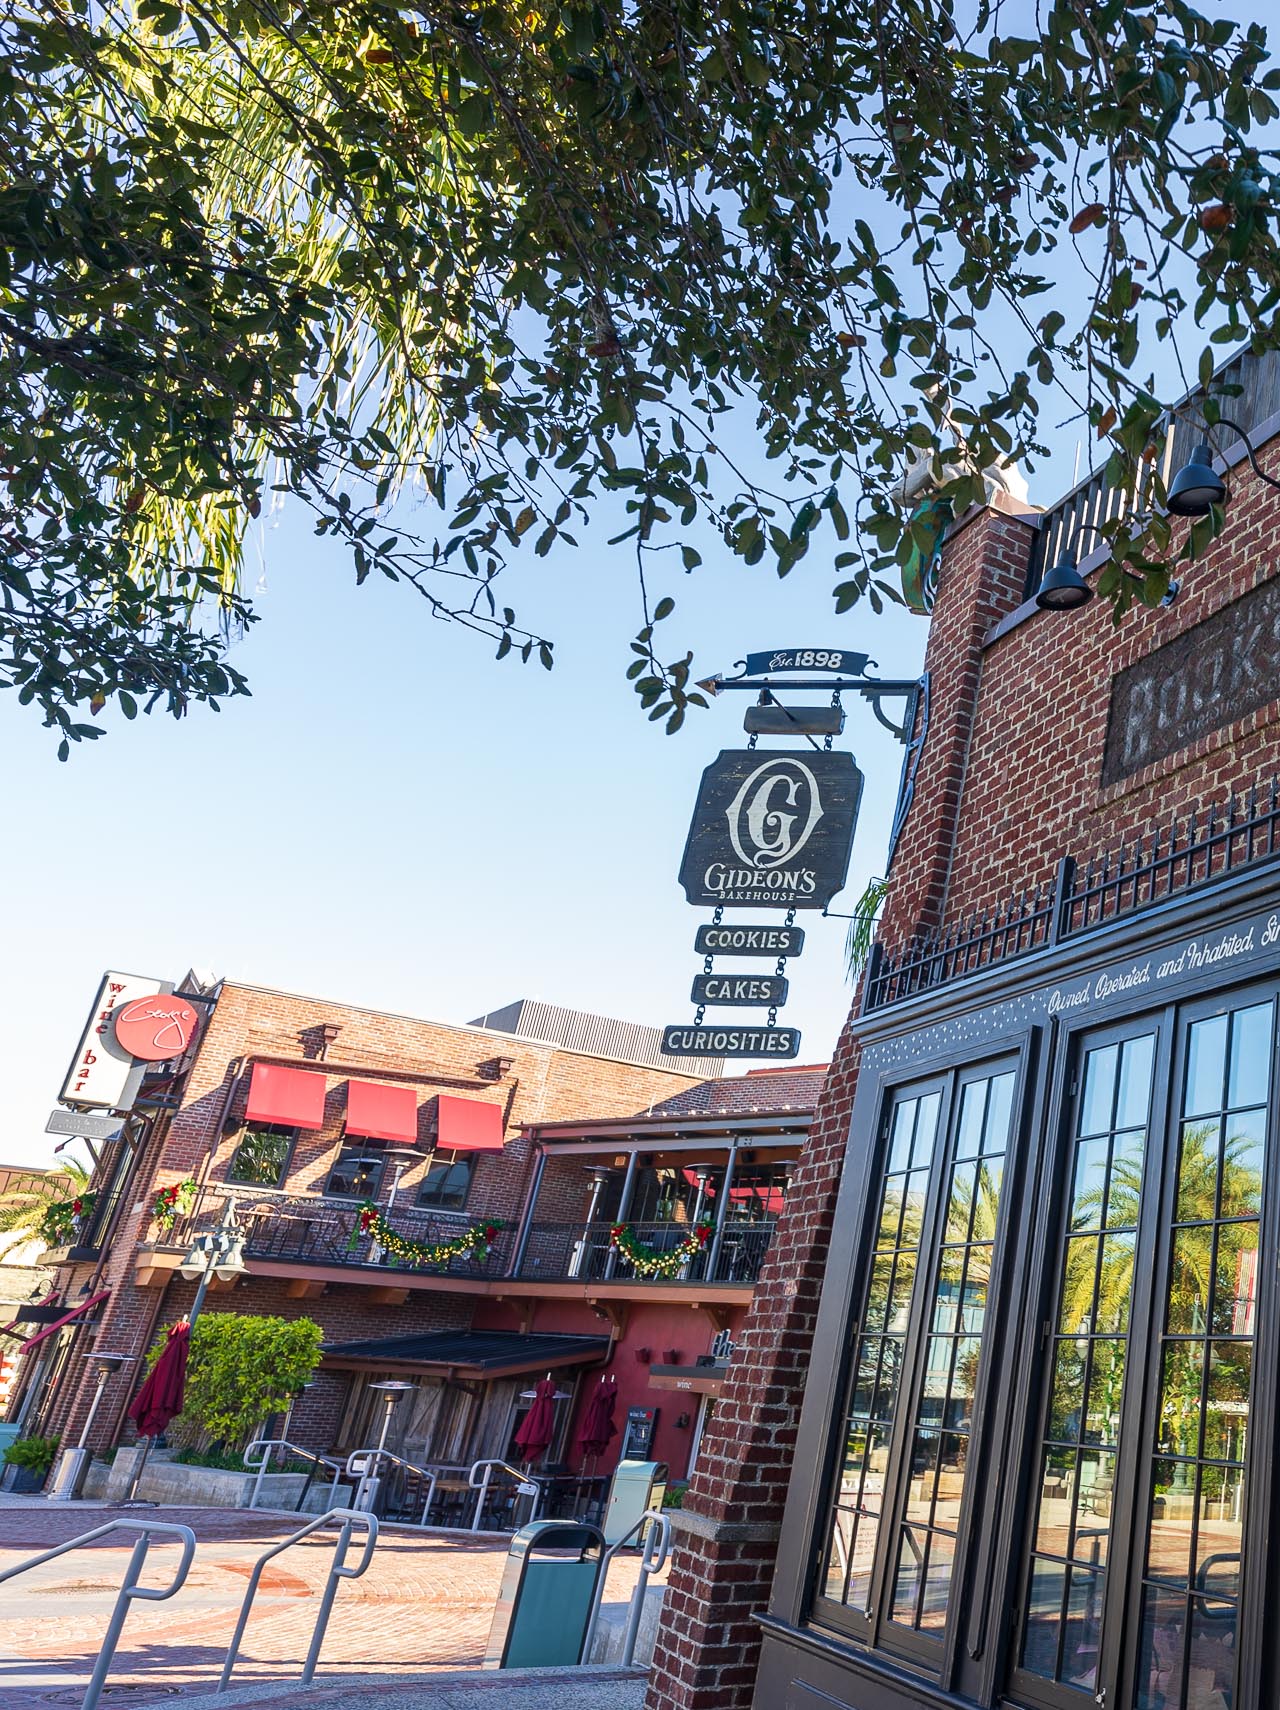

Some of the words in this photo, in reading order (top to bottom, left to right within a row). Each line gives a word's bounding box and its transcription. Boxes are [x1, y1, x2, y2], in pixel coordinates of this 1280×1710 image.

[795, 651, 842, 669] 1898
[703, 862, 816, 894] GIDEON'S
[718, 891, 795, 901] BAKEHOUSE
[705, 931, 790, 949] COOKIES
[1048, 981, 1090, 1014] Owned,
[1095, 965, 1150, 1000] Operated,
[1156, 950, 1184, 979] and
[1187, 927, 1254, 970] Inhabited,
[705, 980, 771, 999] CAKES
[668, 1031, 790, 1051] CURIOSITIES
[74, 1049, 97, 1092] bar
